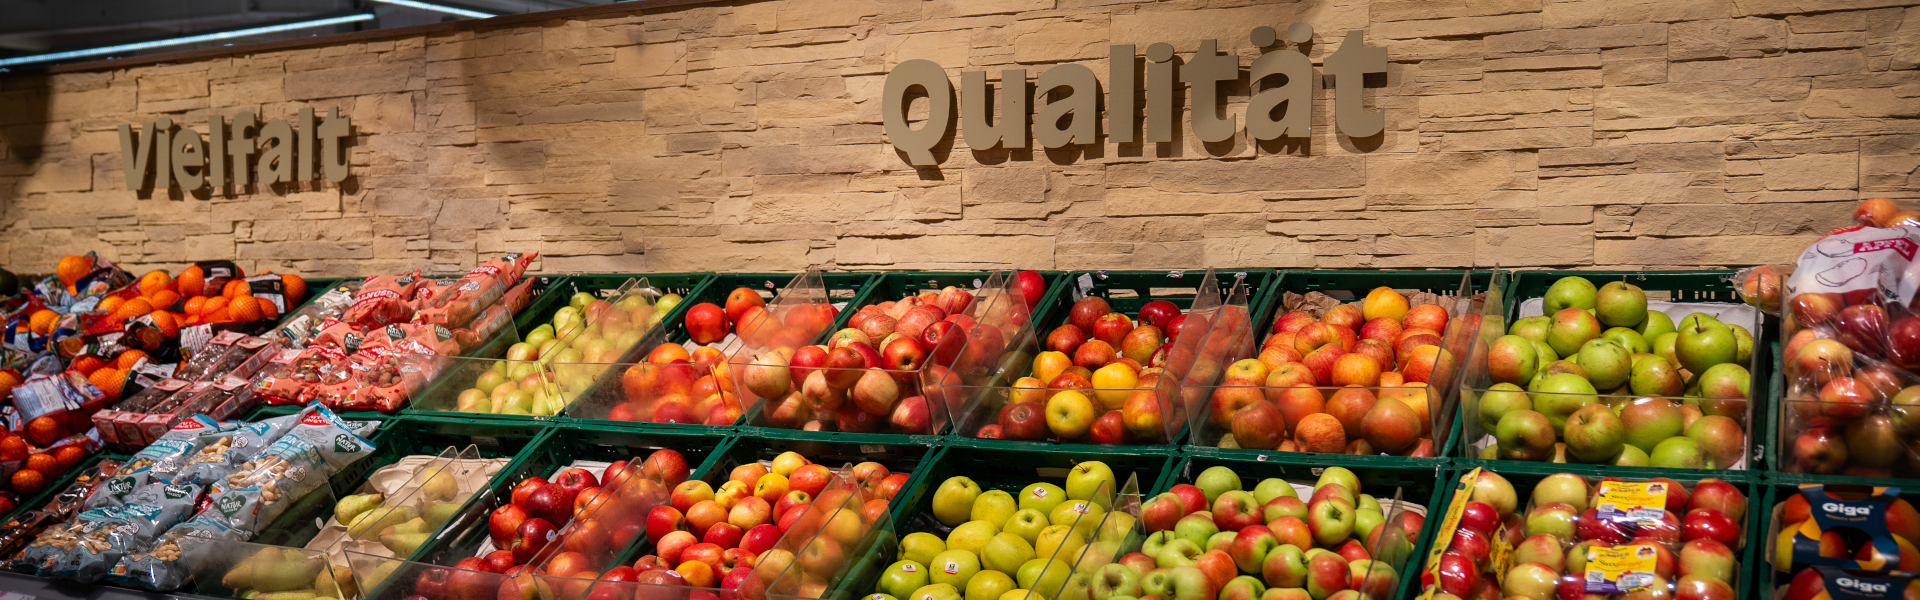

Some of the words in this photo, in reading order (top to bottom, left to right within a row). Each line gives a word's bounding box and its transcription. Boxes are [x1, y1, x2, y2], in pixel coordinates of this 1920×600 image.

[881, 22, 1388, 166] Qualität
[117, 106, 351, 191] Vielfalt
[1859, 238, 1911, 256] APFEL
[1822, 502, 1871, 517] Giga
[1835, 577, 1888, 593] Giga
